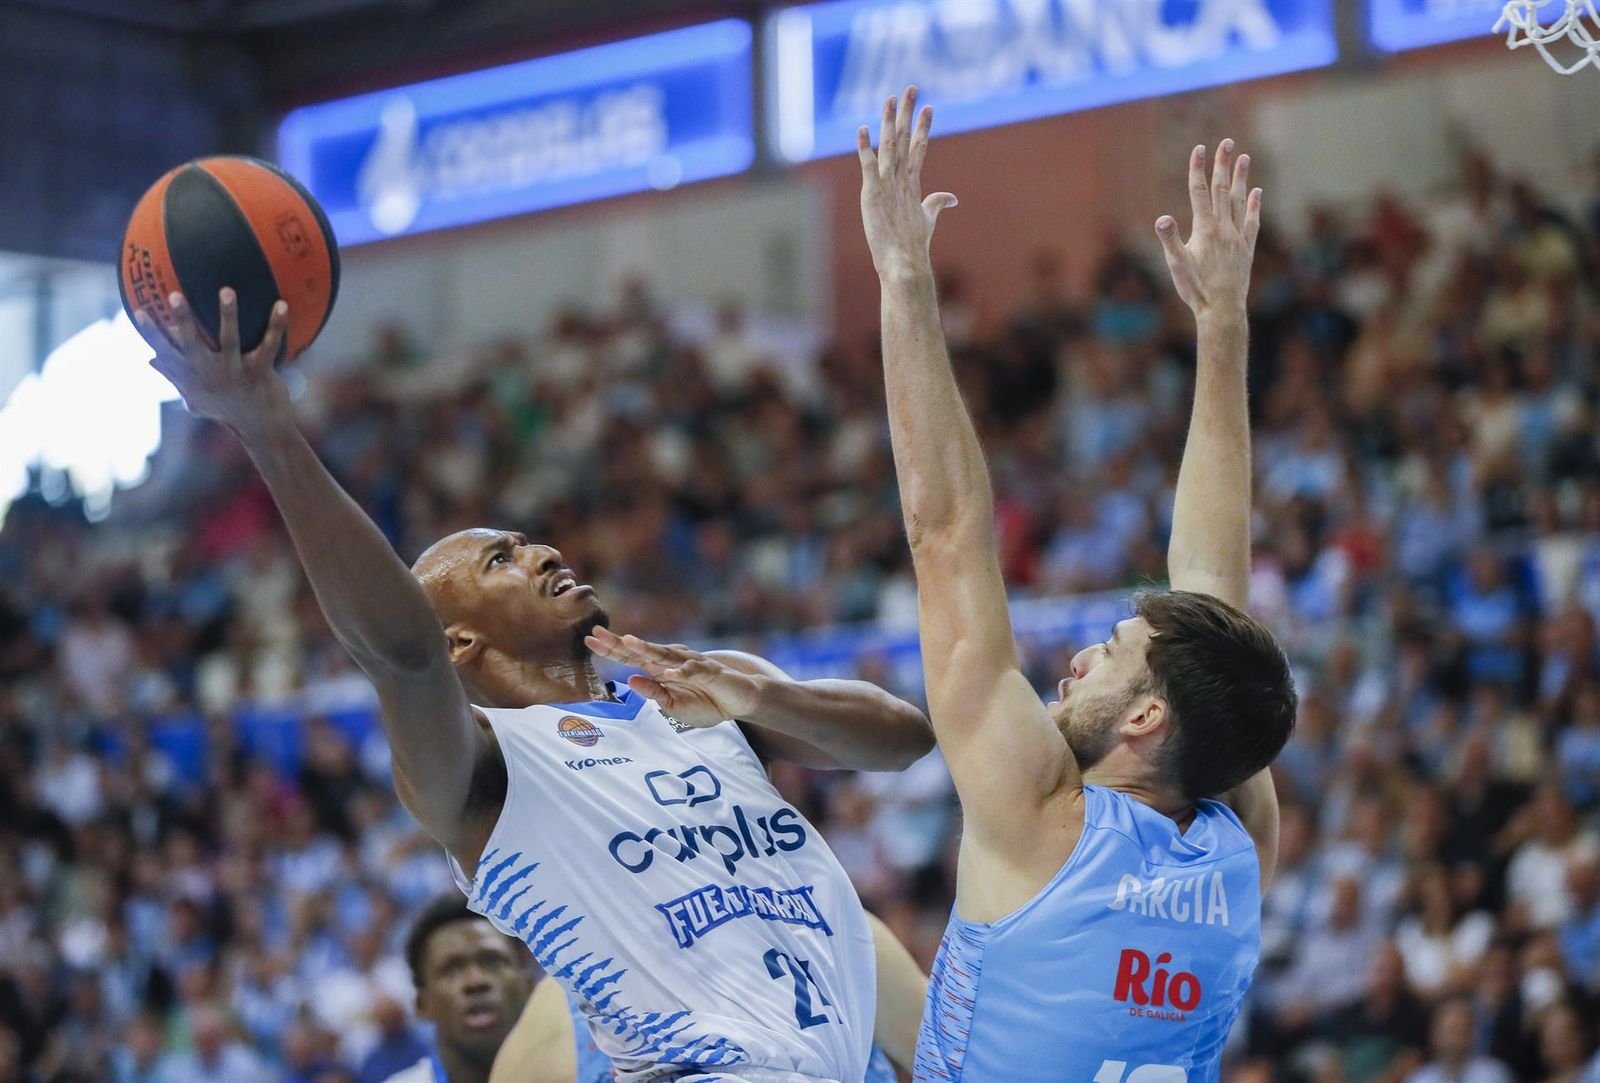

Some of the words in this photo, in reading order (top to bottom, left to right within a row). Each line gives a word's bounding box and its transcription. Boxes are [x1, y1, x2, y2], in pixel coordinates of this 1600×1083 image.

[609, 805, 806, 876] carplus
[1113, 949, 1202, 1012] Río
[1129, 1007, 1144, 1017] DE
